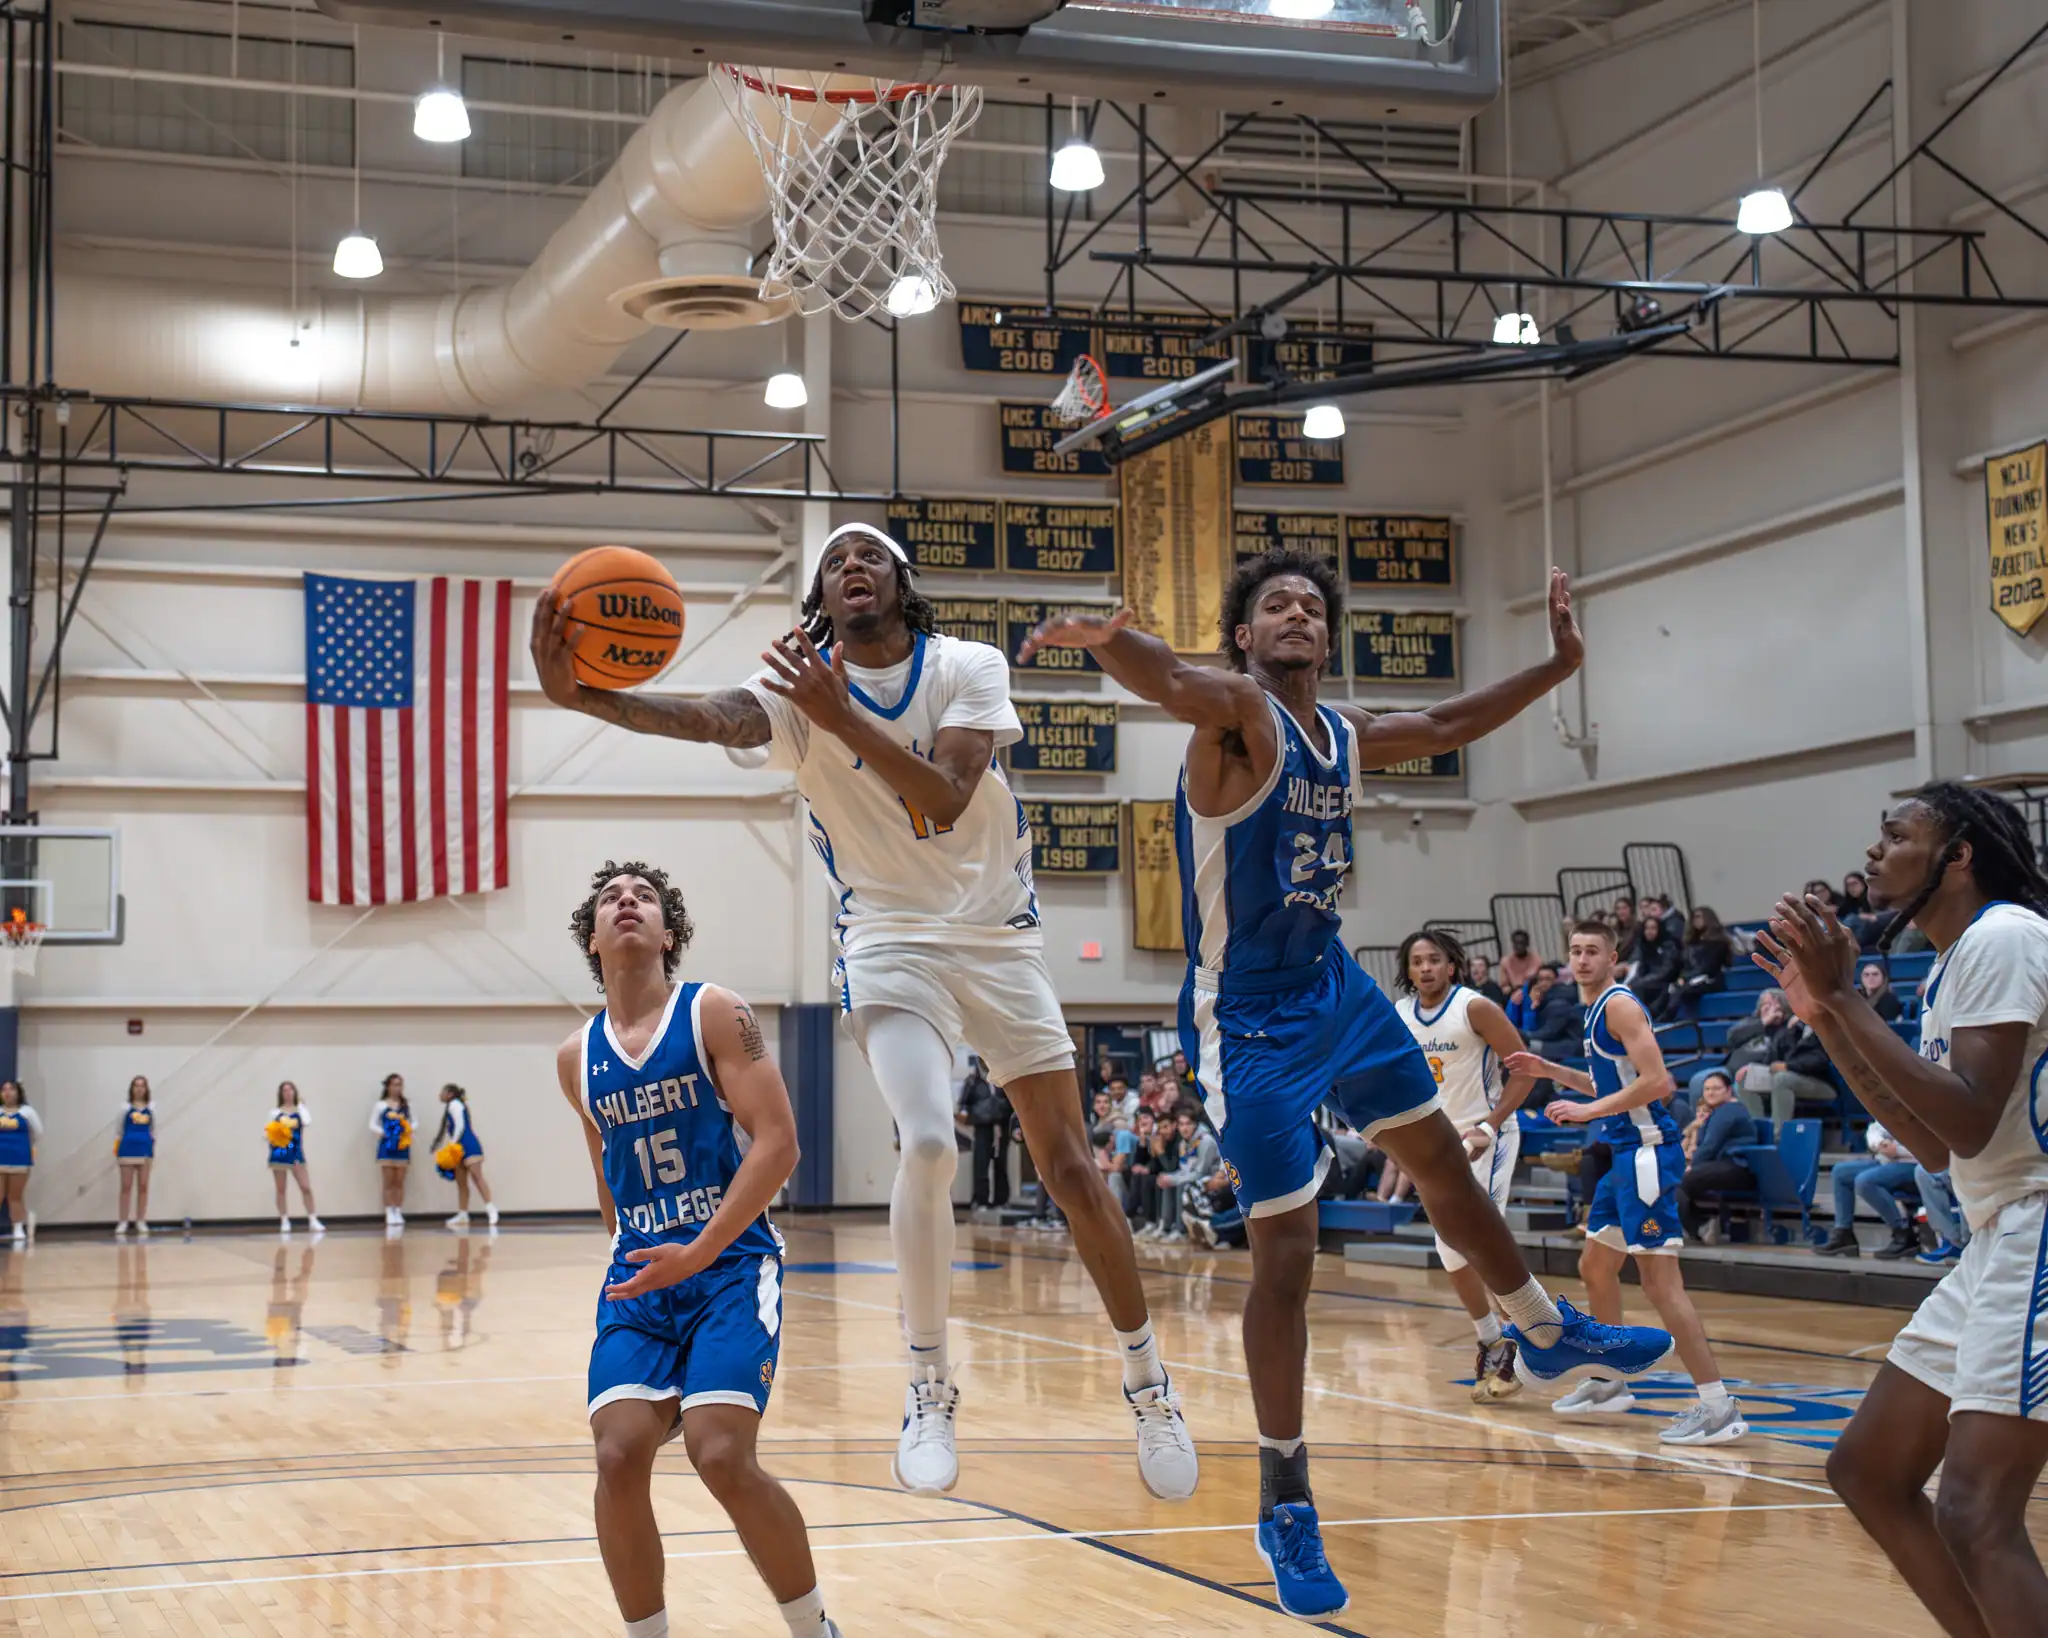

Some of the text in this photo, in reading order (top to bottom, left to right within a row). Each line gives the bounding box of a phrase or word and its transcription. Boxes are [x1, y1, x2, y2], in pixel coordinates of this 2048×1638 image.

[1000, 349, 1054, 371] 2018
[1142, 356, 1197, 377] 2018
[1033, 450, 1080, 471] 2015
[888, 502, 995, 525] AMCC CHAMPIONS
[1006, 505, 1114, 529] AMCC CHAMPIONS
[906, 522, 977, 545] BASEBALL
[1025, 529, 1096, 550] SOFTBALL
[2003, 520, 2038, 549] MEN'S
[916, 546, 968, 567] 2005
[1036, 551, 1086, 571] 2007
[1376, 560, 1422, 581] 2014
[1999, 577, 2045, 607] 2002
[597, 593, 681, 628] Wilson
[1008, 604, 1041, 624] AMCC
[1369, 633, 1435, 656] SOFTBALL
[1036, 648, 1085, 668] 2003
[1380, 655, 1428, 676] 2005
[1017, 704, 1116, 725] MCC CHAMPIONS
[1027, 726, 1098, 747] BASEBALL
[1038, 747, 1088, 768] 2002
[1051, 803, 1117, 825] CHAMPIONS
[1040, 848, 1088, 869] 1998
[1291, 832, 1351, 884] 24
[596, 1073, 699, 1129] HILBERT
[633, 1127, 687, 1190] 15
